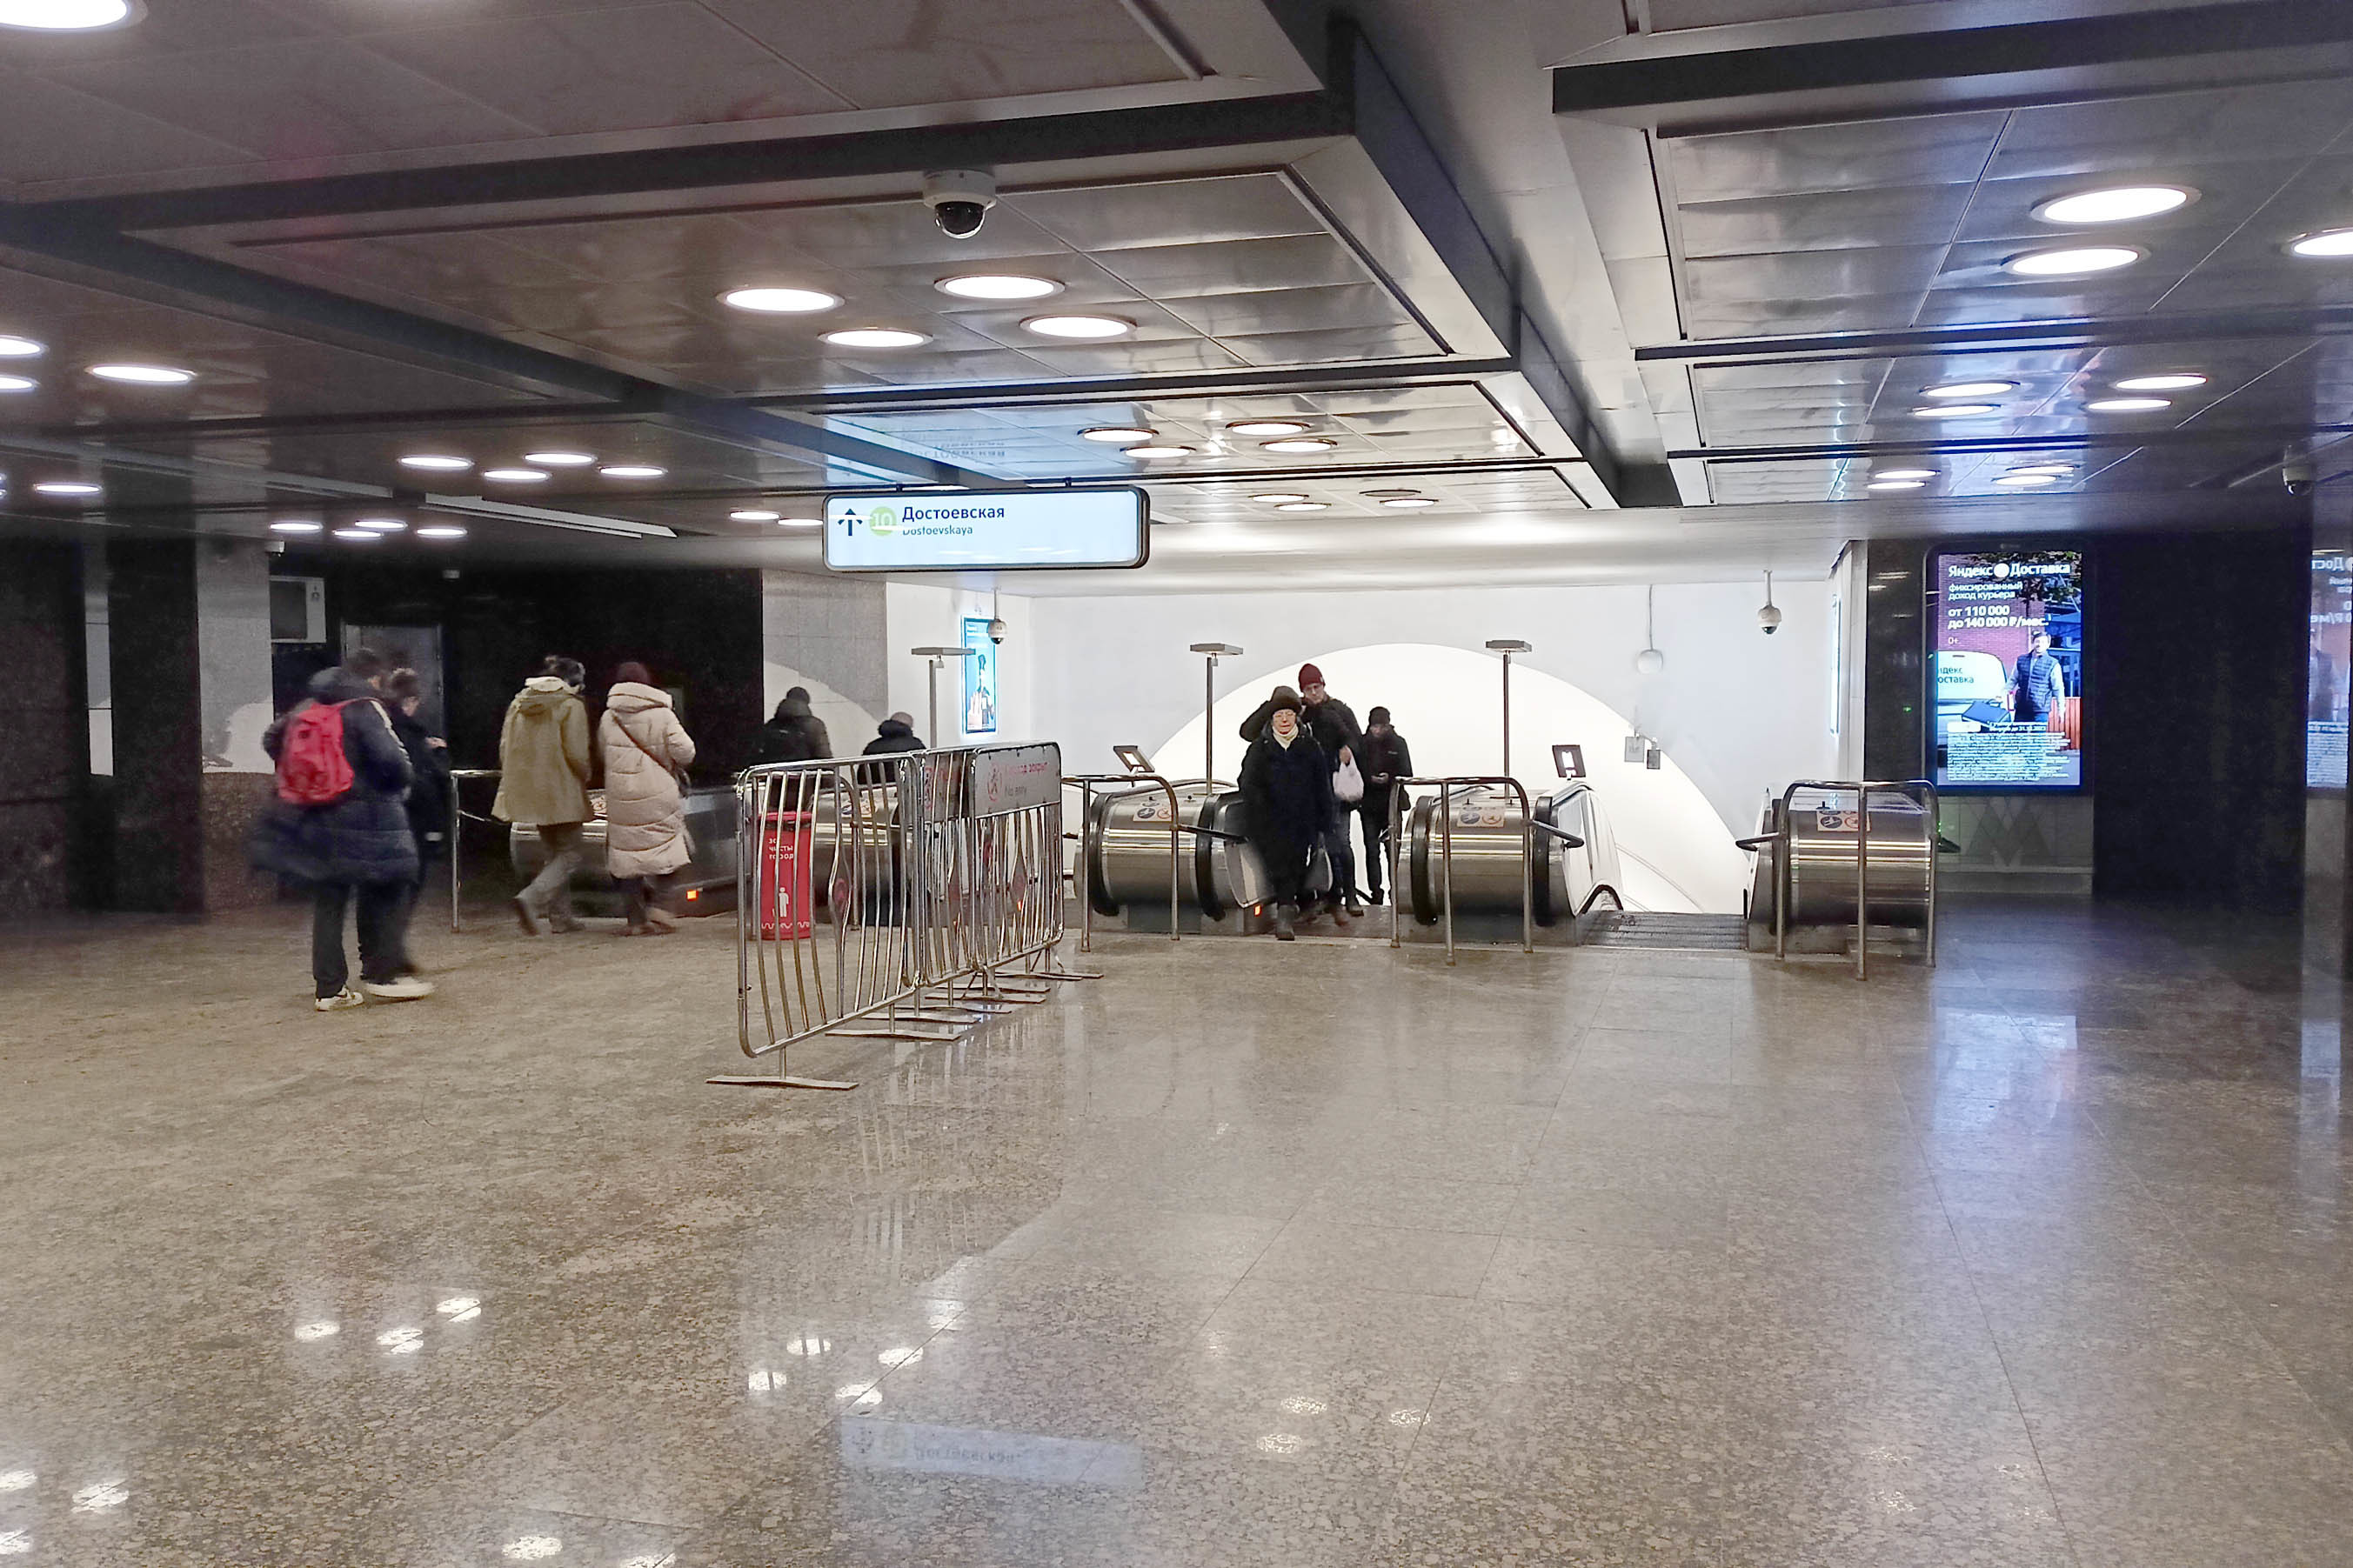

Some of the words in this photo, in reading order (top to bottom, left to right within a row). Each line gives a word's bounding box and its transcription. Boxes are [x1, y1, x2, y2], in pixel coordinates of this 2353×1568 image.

[902, 506, 1005, 523] Достоевская
[1949, 565, 1993, 577] Яндекс
[2009, 563, 2070, 577] Доставка
[1949, 581, 2022, 592] фиксированный
[1977, 591, 2015, 601] курьера
[1965, 605, 1986, 617] 110
[1948, 620, 1964, 630] до
